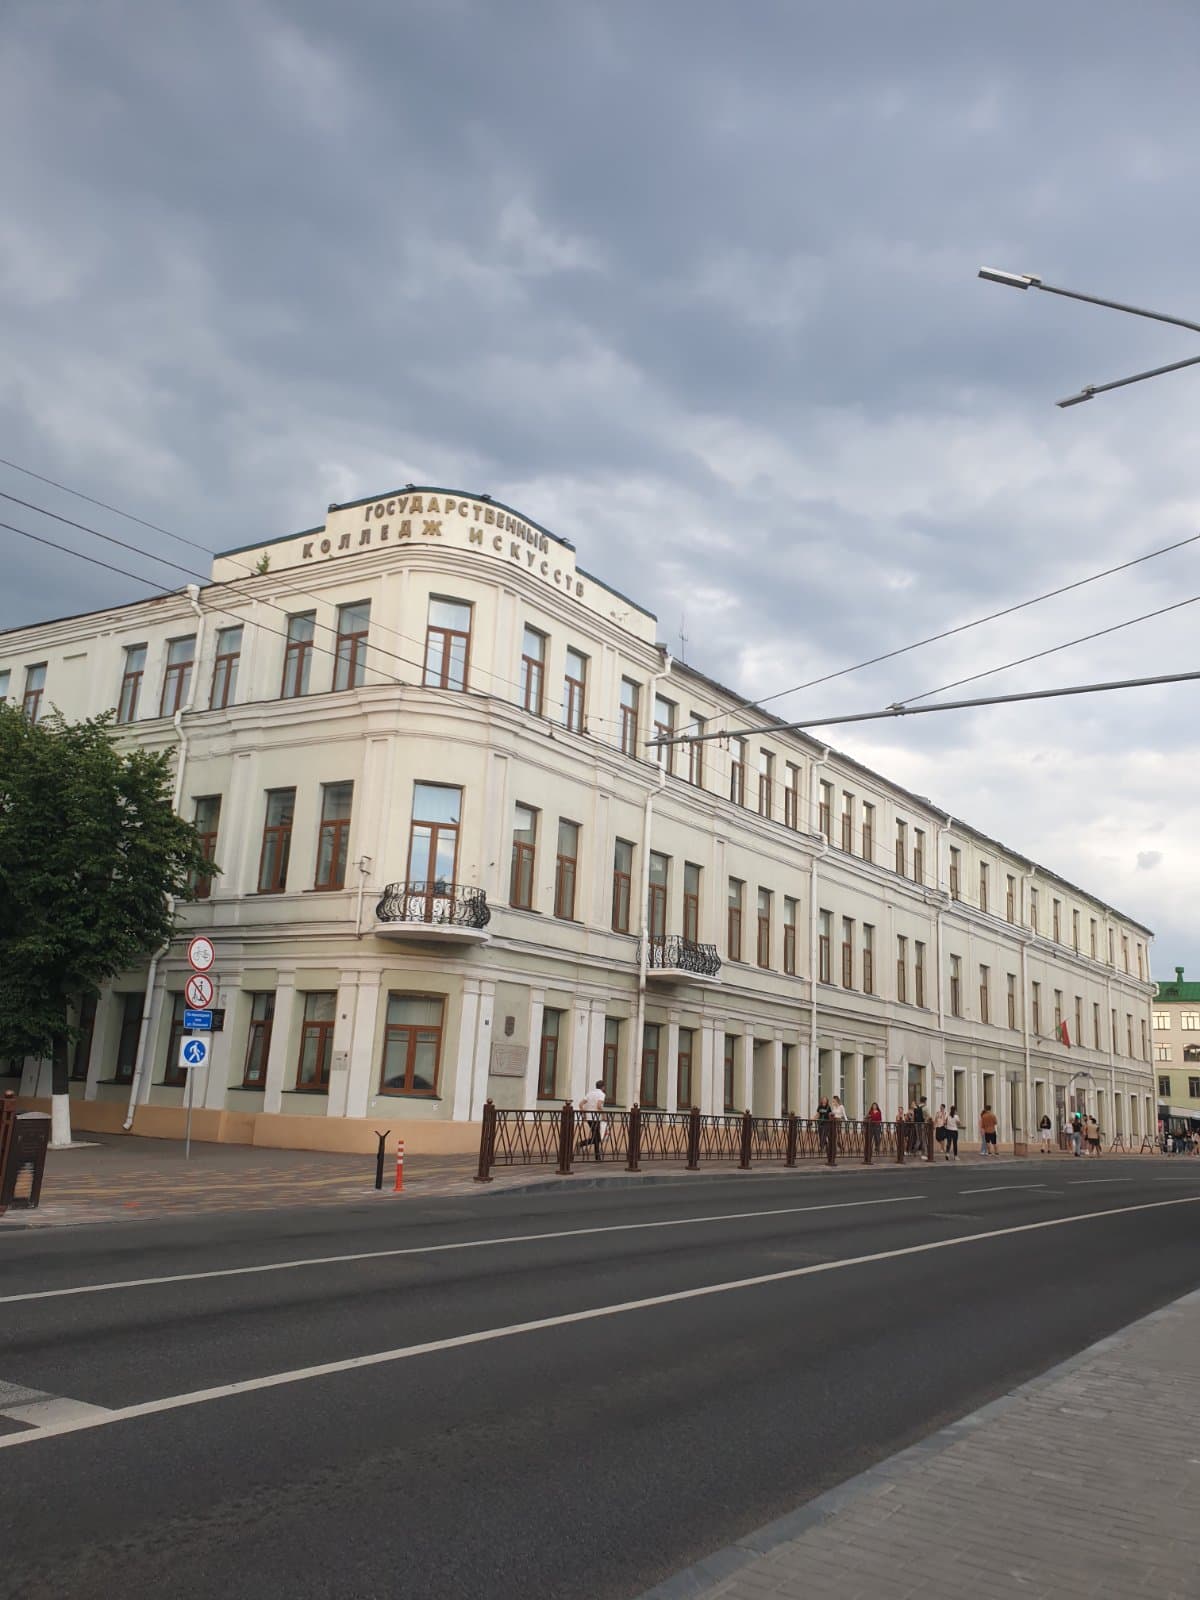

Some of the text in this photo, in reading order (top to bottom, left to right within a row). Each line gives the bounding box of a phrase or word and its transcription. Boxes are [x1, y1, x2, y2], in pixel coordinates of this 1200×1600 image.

[302, 519, 585, 598] КОЛЛЕДЖ ИСКУССТВ
[365, 495, 550, 554] ГОСУДАРСТВЕННЫЙ
